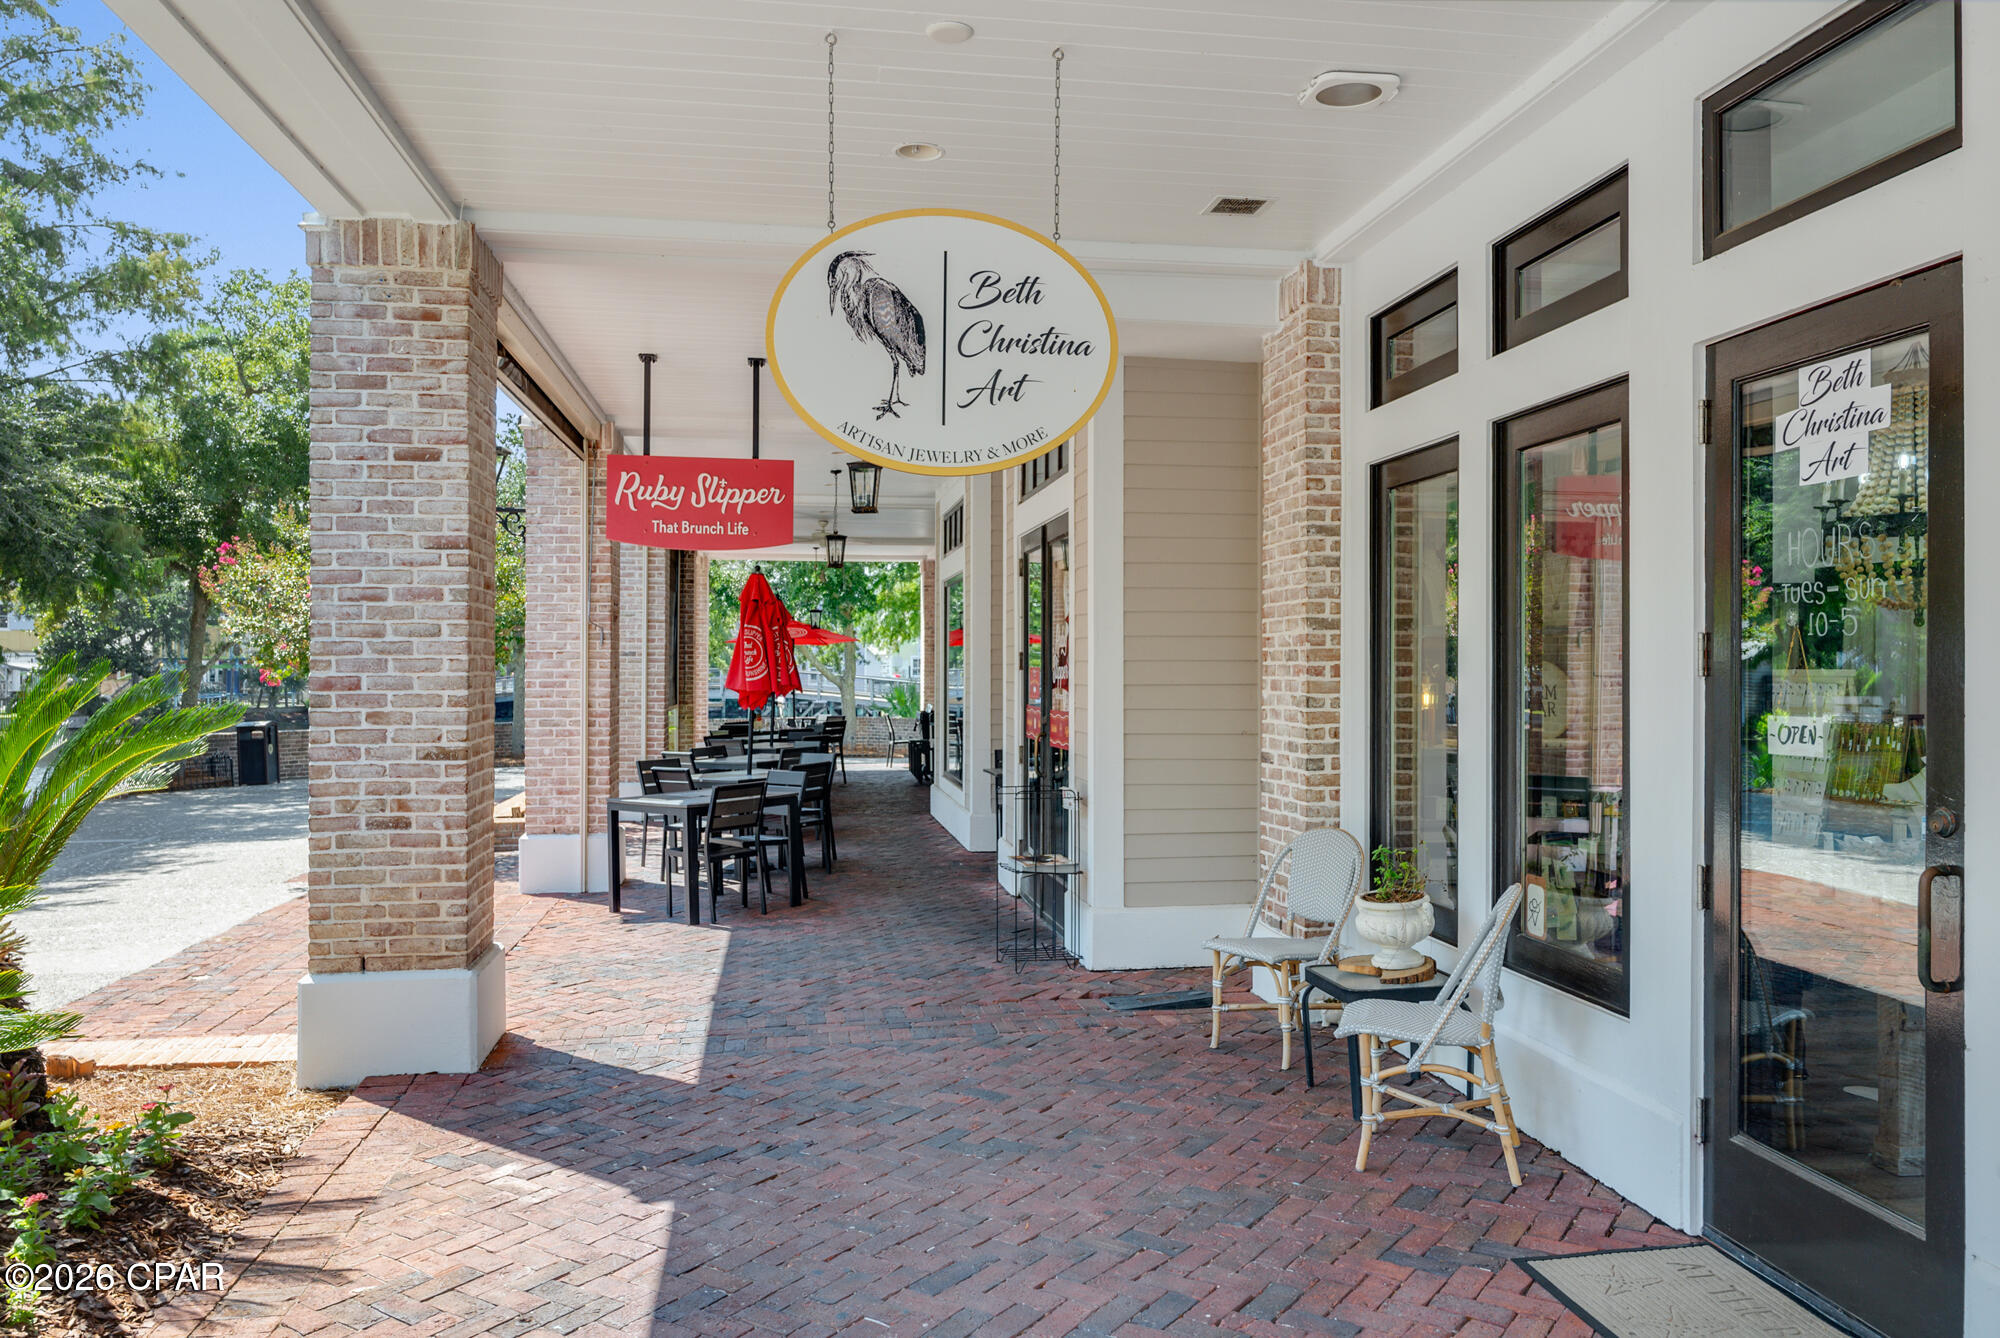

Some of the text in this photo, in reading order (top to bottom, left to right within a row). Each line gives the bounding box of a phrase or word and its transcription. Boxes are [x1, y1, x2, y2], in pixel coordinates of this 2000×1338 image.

[957, 270, 1048, 310] Beth
[957, 319, 1096, 358] Christina
[956, 368, 1046, 409] Art
[1800, 359, 1865, 407] Beth
[837, 421, 1049, 464] ARTISAN JEWELRY & MORE
[1782, 400, 1887, 446] Christina
[1801, 441, 1867, 482] Art
[614, 471, 786, 515] Ruby Slipper
[652, 520, 749, 535] That Brunch Life
[1787, 521, 1876, 568] HOURS
[1807, 607, 1858, 637] 10-5
